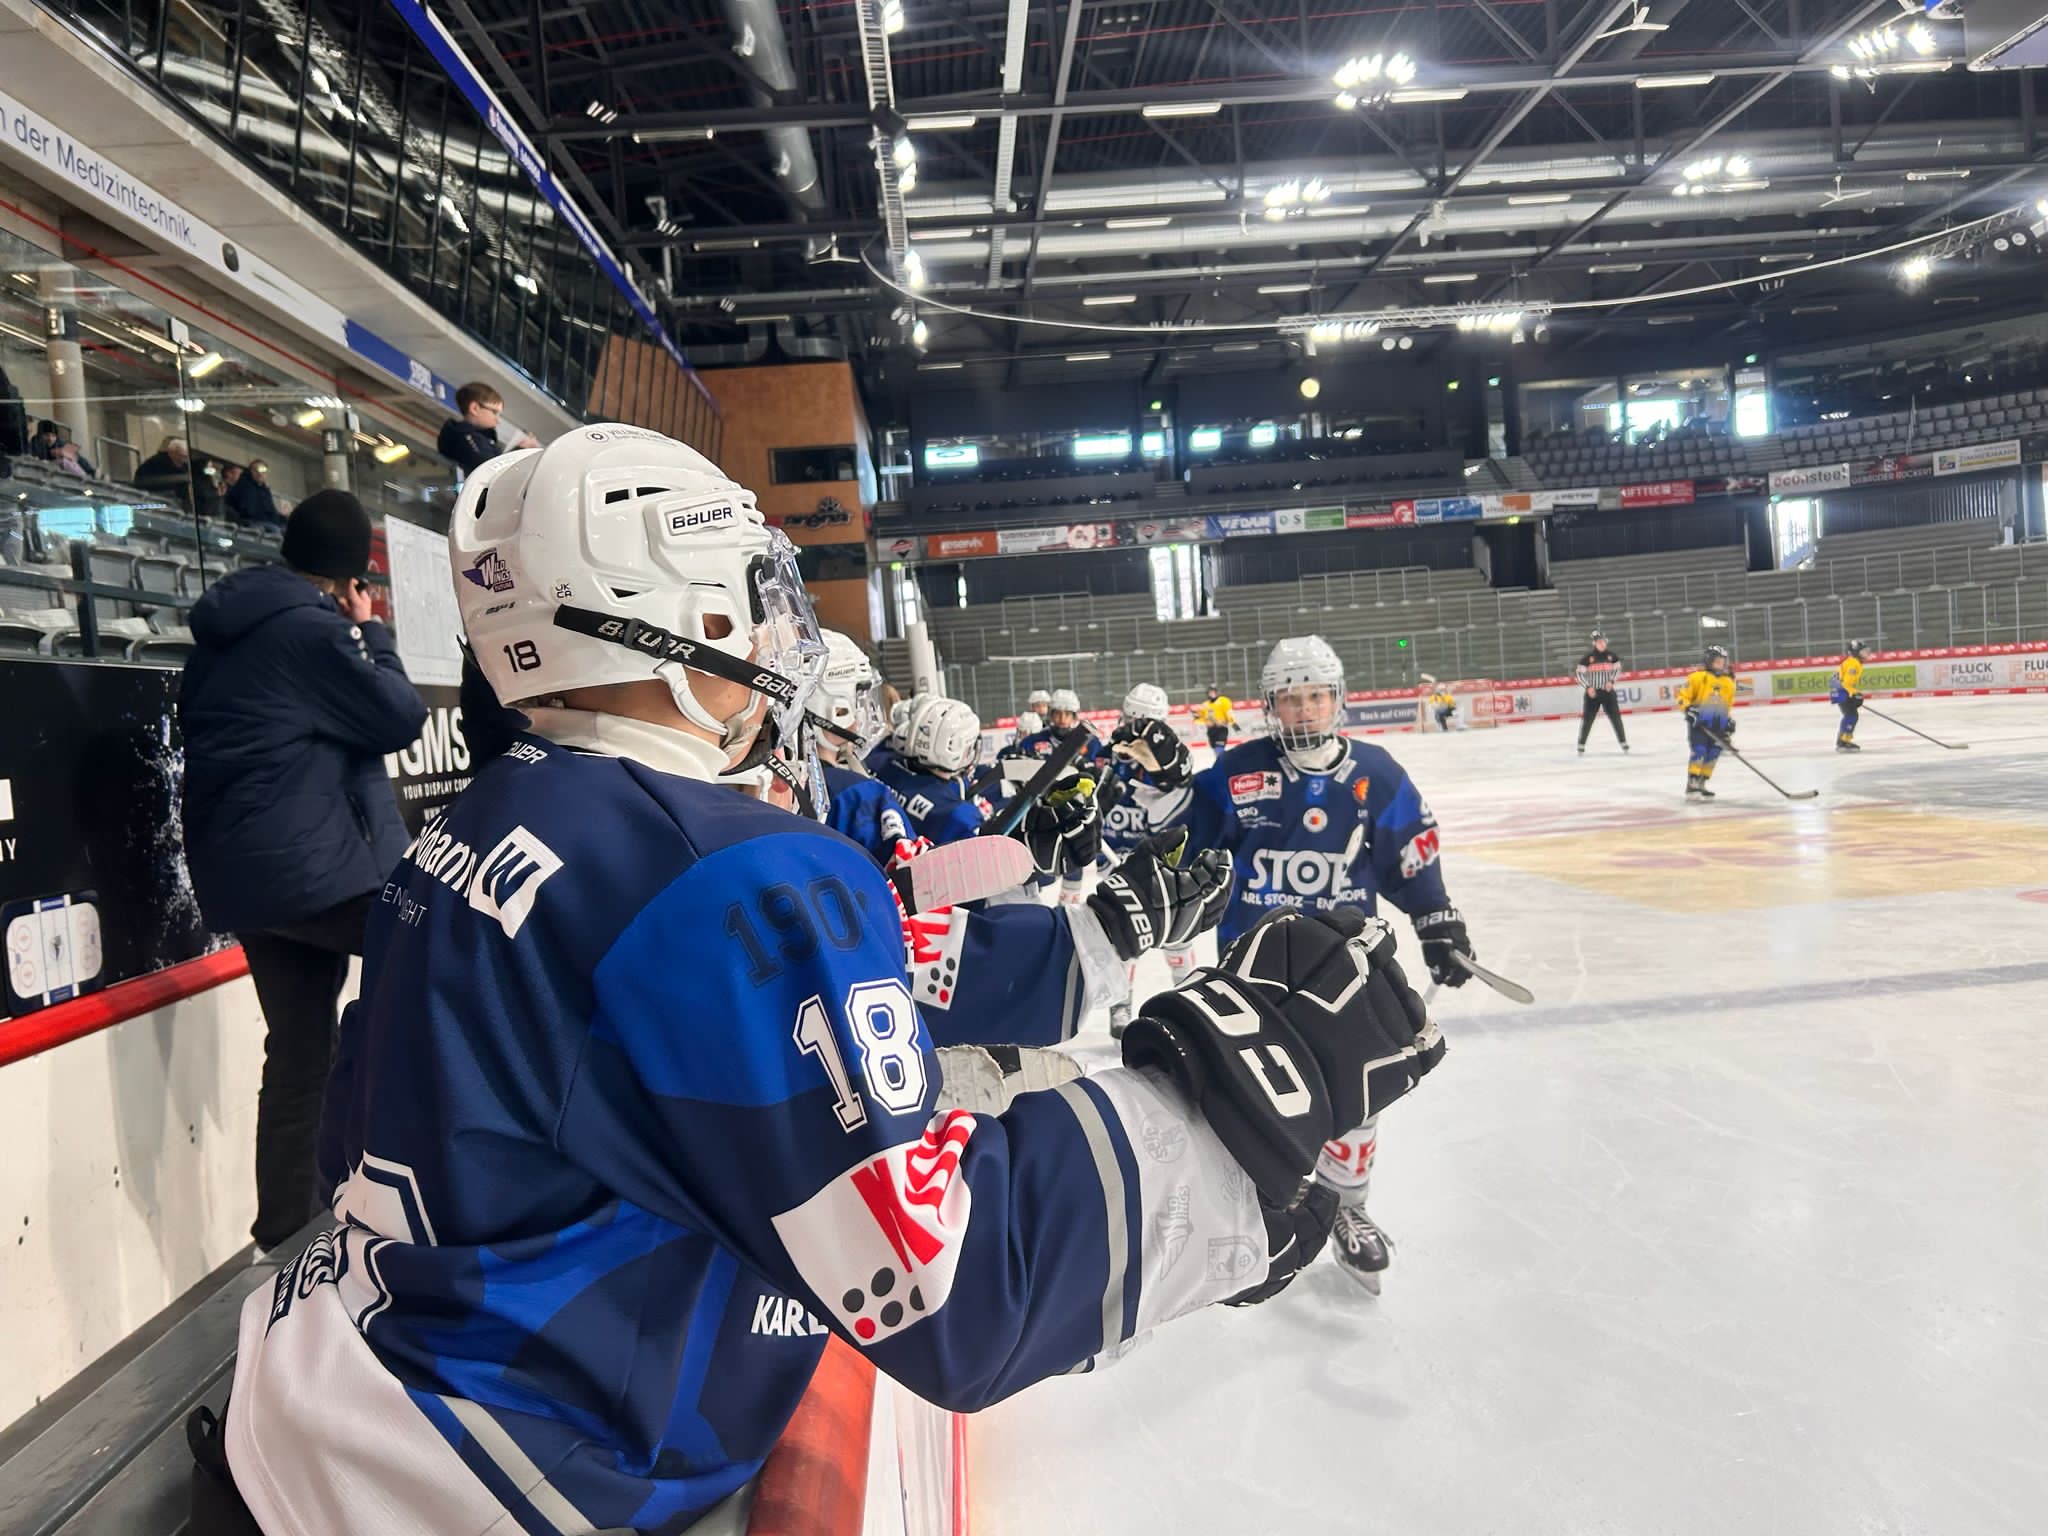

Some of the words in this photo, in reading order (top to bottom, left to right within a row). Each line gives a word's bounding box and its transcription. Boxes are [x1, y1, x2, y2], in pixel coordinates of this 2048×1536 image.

[14, 114, 50, 157] der
[56, 136, 197, 247] Medizintechnik.
[503, 640, 541, 672] 18
[1951, 662, 1993, 674] FLUCK
[403, 784, 423, 800] YOUR
[425, 781, 453, 798] DISPLAY
[1241, 891, 1262, 906] ARL
[1264, 893, 1304, 909] STORZ
[725, 875, 868, 986] 190
[792, 977, 928, 1134] 18
